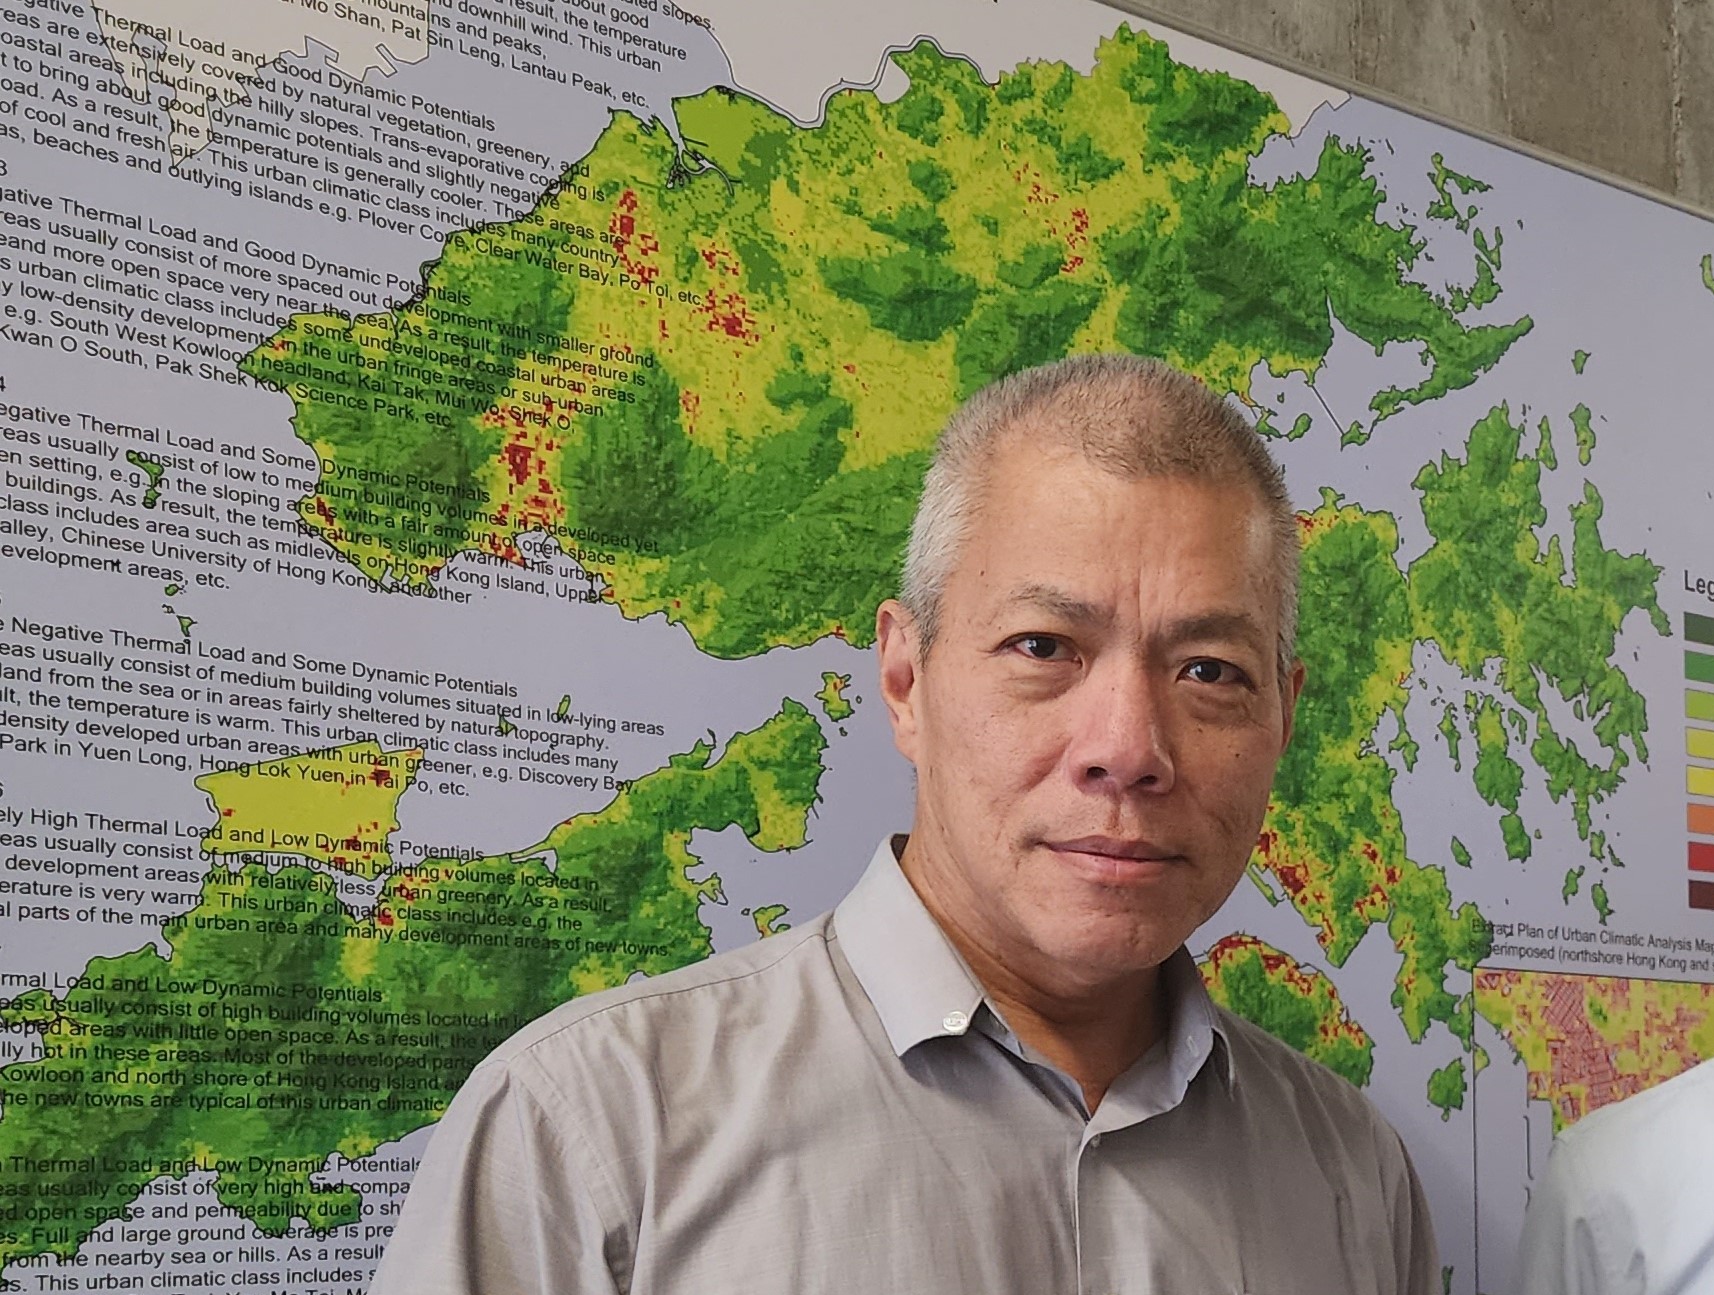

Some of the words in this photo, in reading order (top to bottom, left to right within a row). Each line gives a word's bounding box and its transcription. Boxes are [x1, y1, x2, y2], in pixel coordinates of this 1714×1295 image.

[93, 6, 171, 42] Thermal
[179, 30, 225, 56] Load
[231, 47, 267, 68] and
[272, 57, 321, 84] Good
[328, 68, 407, 107] Dynamic
[411, 96, 496, 132] Potentials
[334, 3, 385, 33] Shan,
[392, 20, 421, 41] Pat
[426, 29, 455, 51] Sin
[459, 38, 505, 69] Leng,
[512, 51, 567, 83] Lantau
[572, 71, 616, 100] Peak,
[621, 88, 650, 109] etc.
[60, 336, 77, 352] O
[84, 341, 148, 370] South,
[156, 354, 193, 377] Pak
[199, 363, 248, 387] Shek
[254, 376, 289, 397] Kok
[295, 383, 368, 411] Science
[77, 413, 159, 444] Thermal
[167, 430, 213, 453] Load
[220, 442, 255, 460] and
[261, 447, 316, 472] Some
[322, 457, 399, 486] Dynamic
[405, 473, 491, 504] Potentials
[61, 525, 145, 554] Chinese
[152, 540, 246, 574] University
[253, 556, 271, 573] of
[278, 560, 326, 586] Hong
[12, 617, 103, 643] Negative
[110, 629, 191, 656] Thermal
[198, 641, 245, 662] Load
[252, 650, 286, 668] and
[293, 654, 346, 675] Some
[352, 662, 430, 688] Dynamic
[435, 673, 518, 699] Potentials
[48, 668, 94, 689] from
[102, 673, 133, 693] the
[139, 682, 174, 698] sea
[181, 686, 203, 701] or
[207, 686, 222, 703] in
[229, 693, 282, 711] areas
[288, 698, 332, 720] fairly
[338, 704, 421, 730] sheltered
[425, 711, 446, 734] by
[451, 719, 508, 738] natural
[514, 725, 609, 752] topography.
[1, 733, 47, 753] Park
[54, 738, 71, 756] in
[79, 742, 130, 763] Yuen
[139, 748, 192, 771] Long,
[199, 754, 249, 777] Hong
[258, 758, 289, 778] Lok
[297, 763, 348, 786] Yuen,
[1518, 922, 1544, 939] Plan
[1547, 926, 1559, 940] of
[1562, 926, 1596, 943] Urban
[1600, 929, 1645, 947] Climatic
[1647, 934, 1692, 953] Analysis
[1558, 946, 1623, 965] (northshore
[1626, 951, 1656, 970] Hong
[1659, 955, 1686, 973] Kong
[1690, 959, 1709, 972] and
